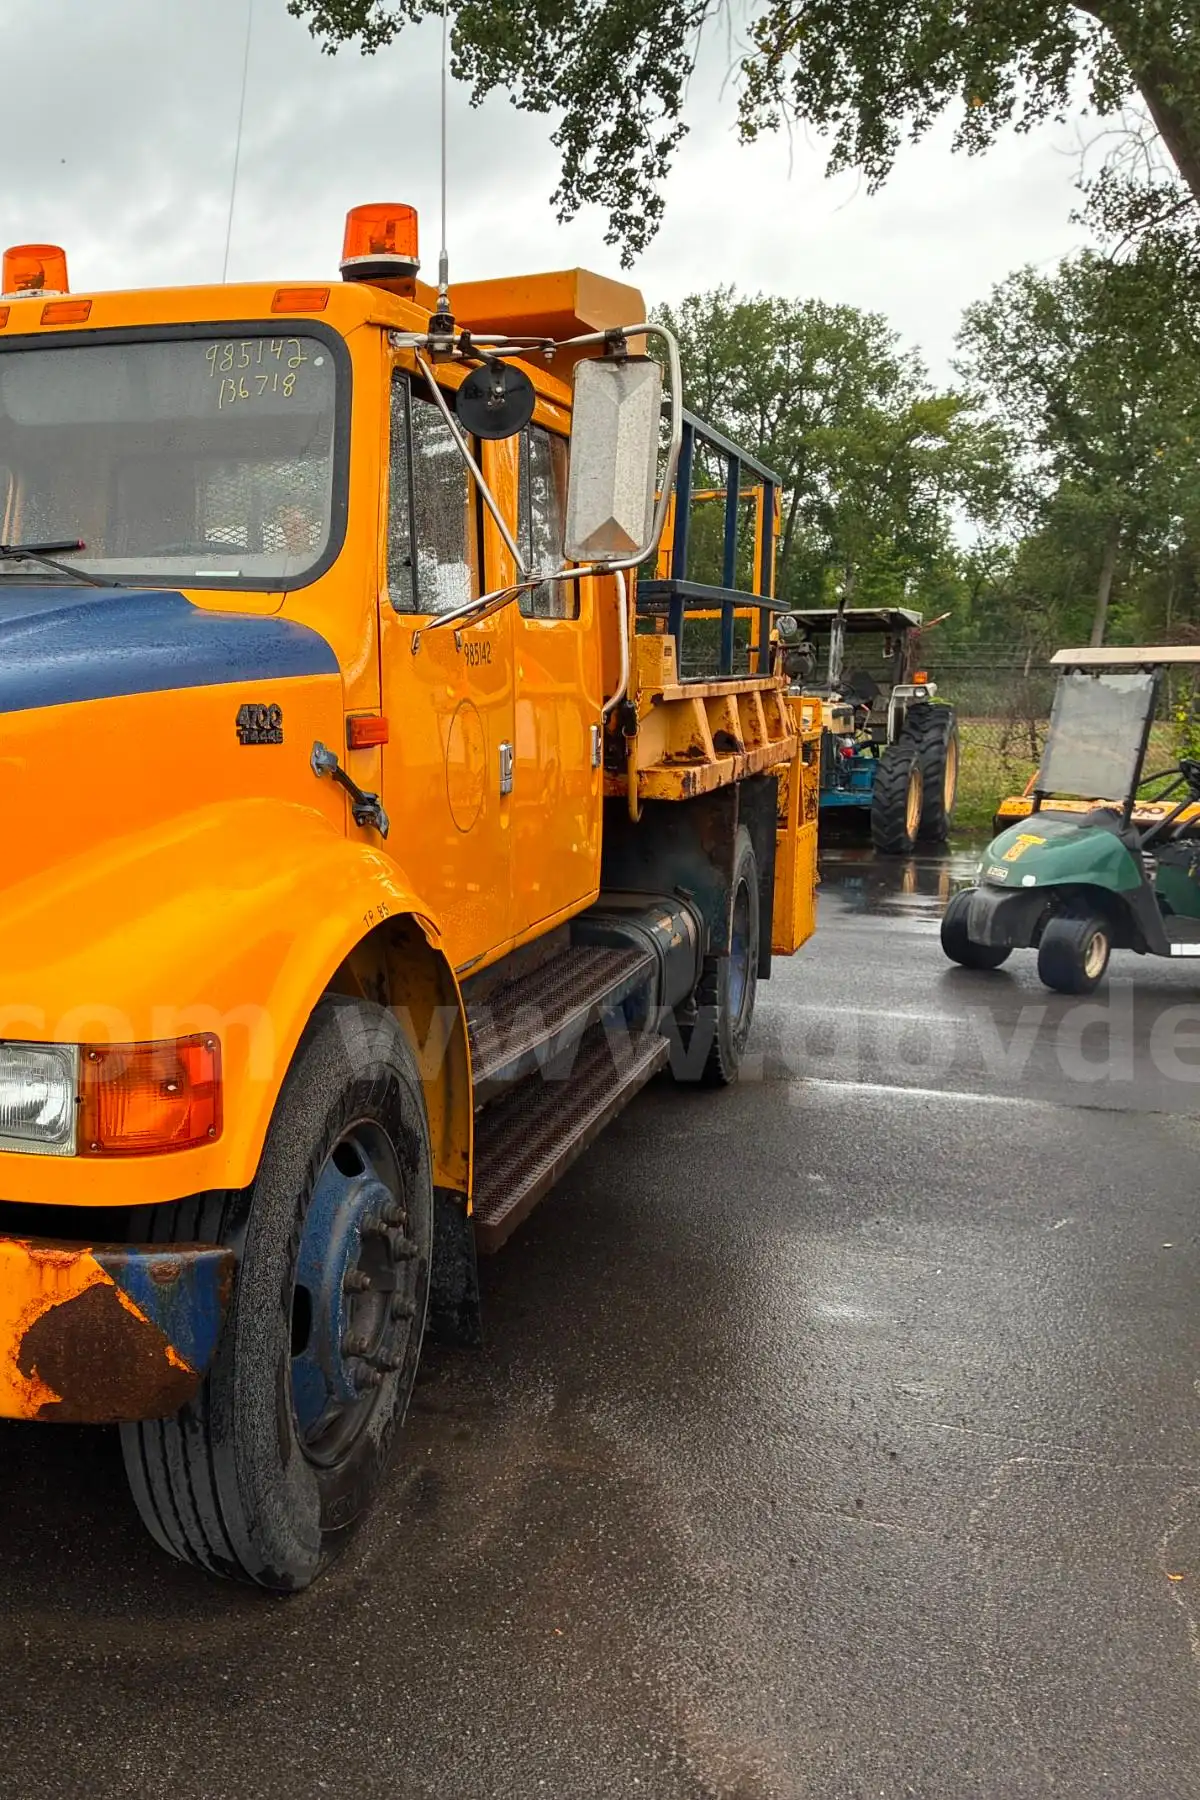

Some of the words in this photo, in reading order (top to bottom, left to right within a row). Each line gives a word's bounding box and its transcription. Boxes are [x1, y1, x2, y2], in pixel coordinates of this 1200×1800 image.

[205, 338, 308, 377] 985142
[218, 372, 296, 409] 136718
[463, 641, 492, 666] 985142
